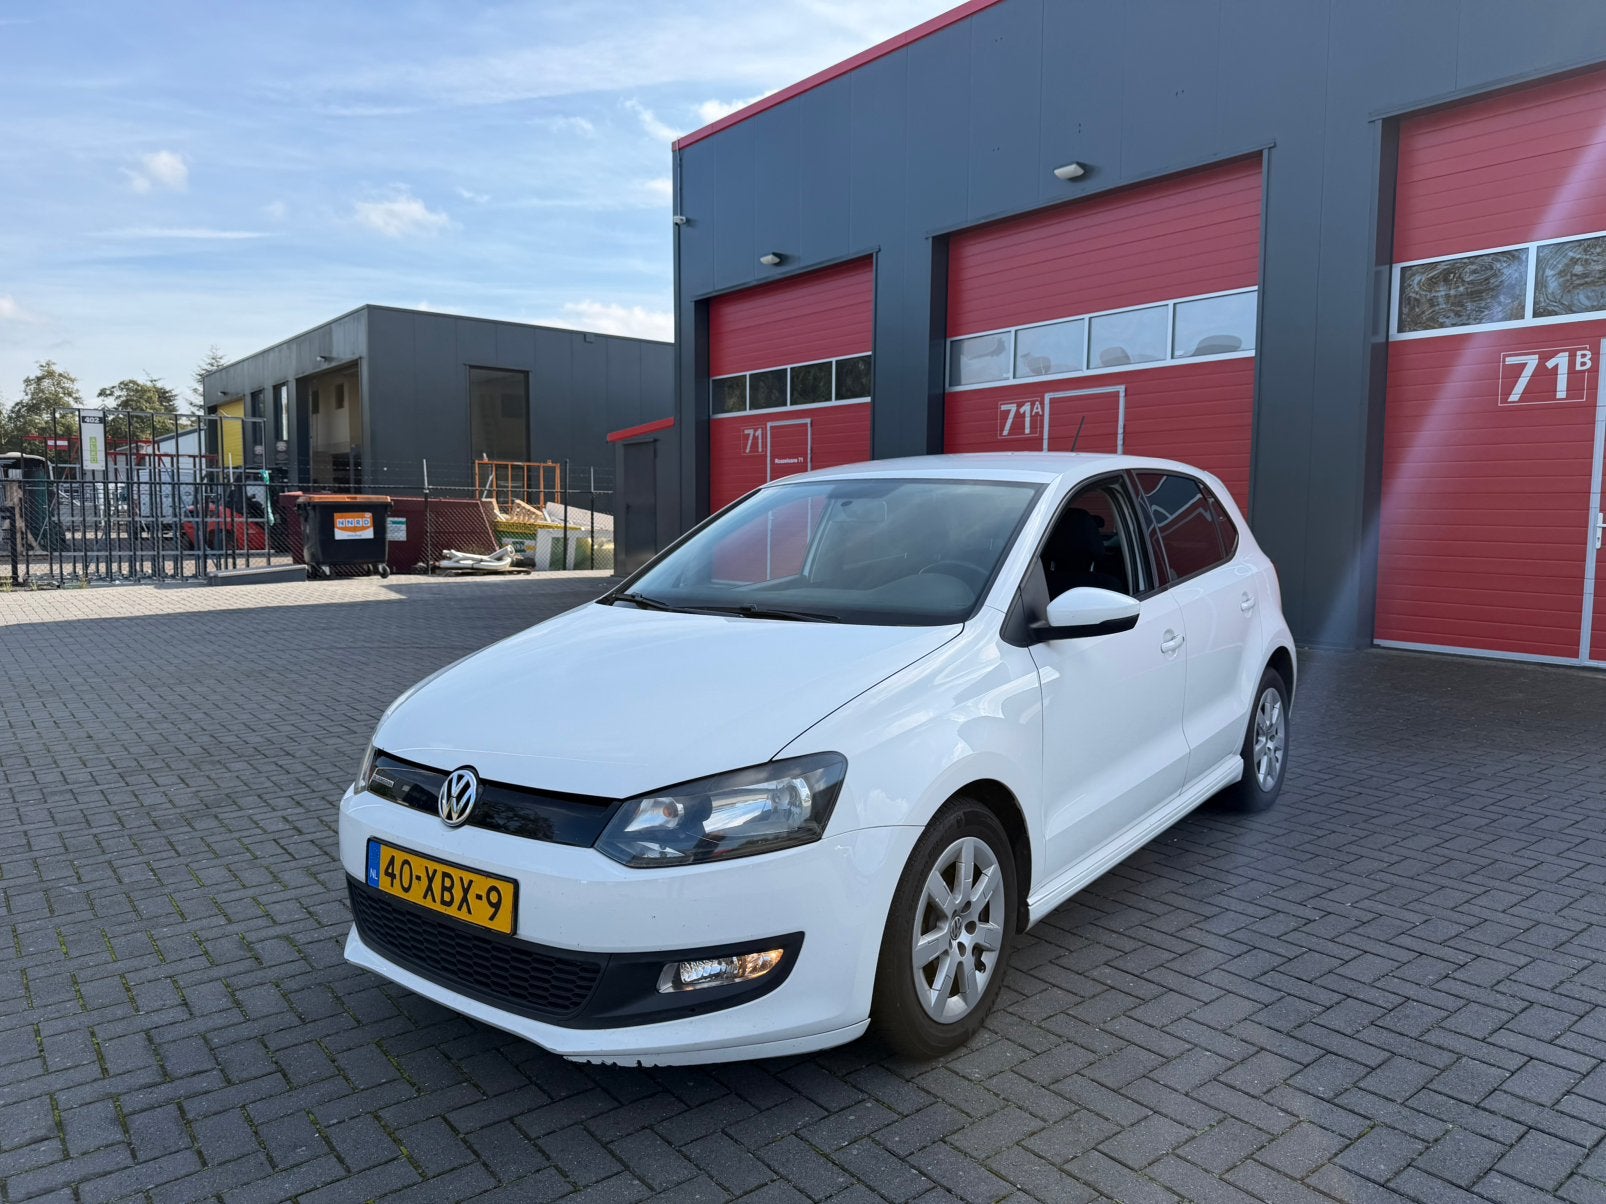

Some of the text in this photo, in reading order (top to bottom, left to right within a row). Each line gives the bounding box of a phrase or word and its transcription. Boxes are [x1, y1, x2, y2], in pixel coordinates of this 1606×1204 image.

[1505, 351, 1592, 402] 71B
[84, 416, 100, 424] 402
[1000, 401, 1042, 436] 71A
[743, 428, 762, 454] 71
[798, 456, 804, 464] 71
[369, 868, 378, 880] NL
[383, 854, 503, 922] 40-XBX-9
